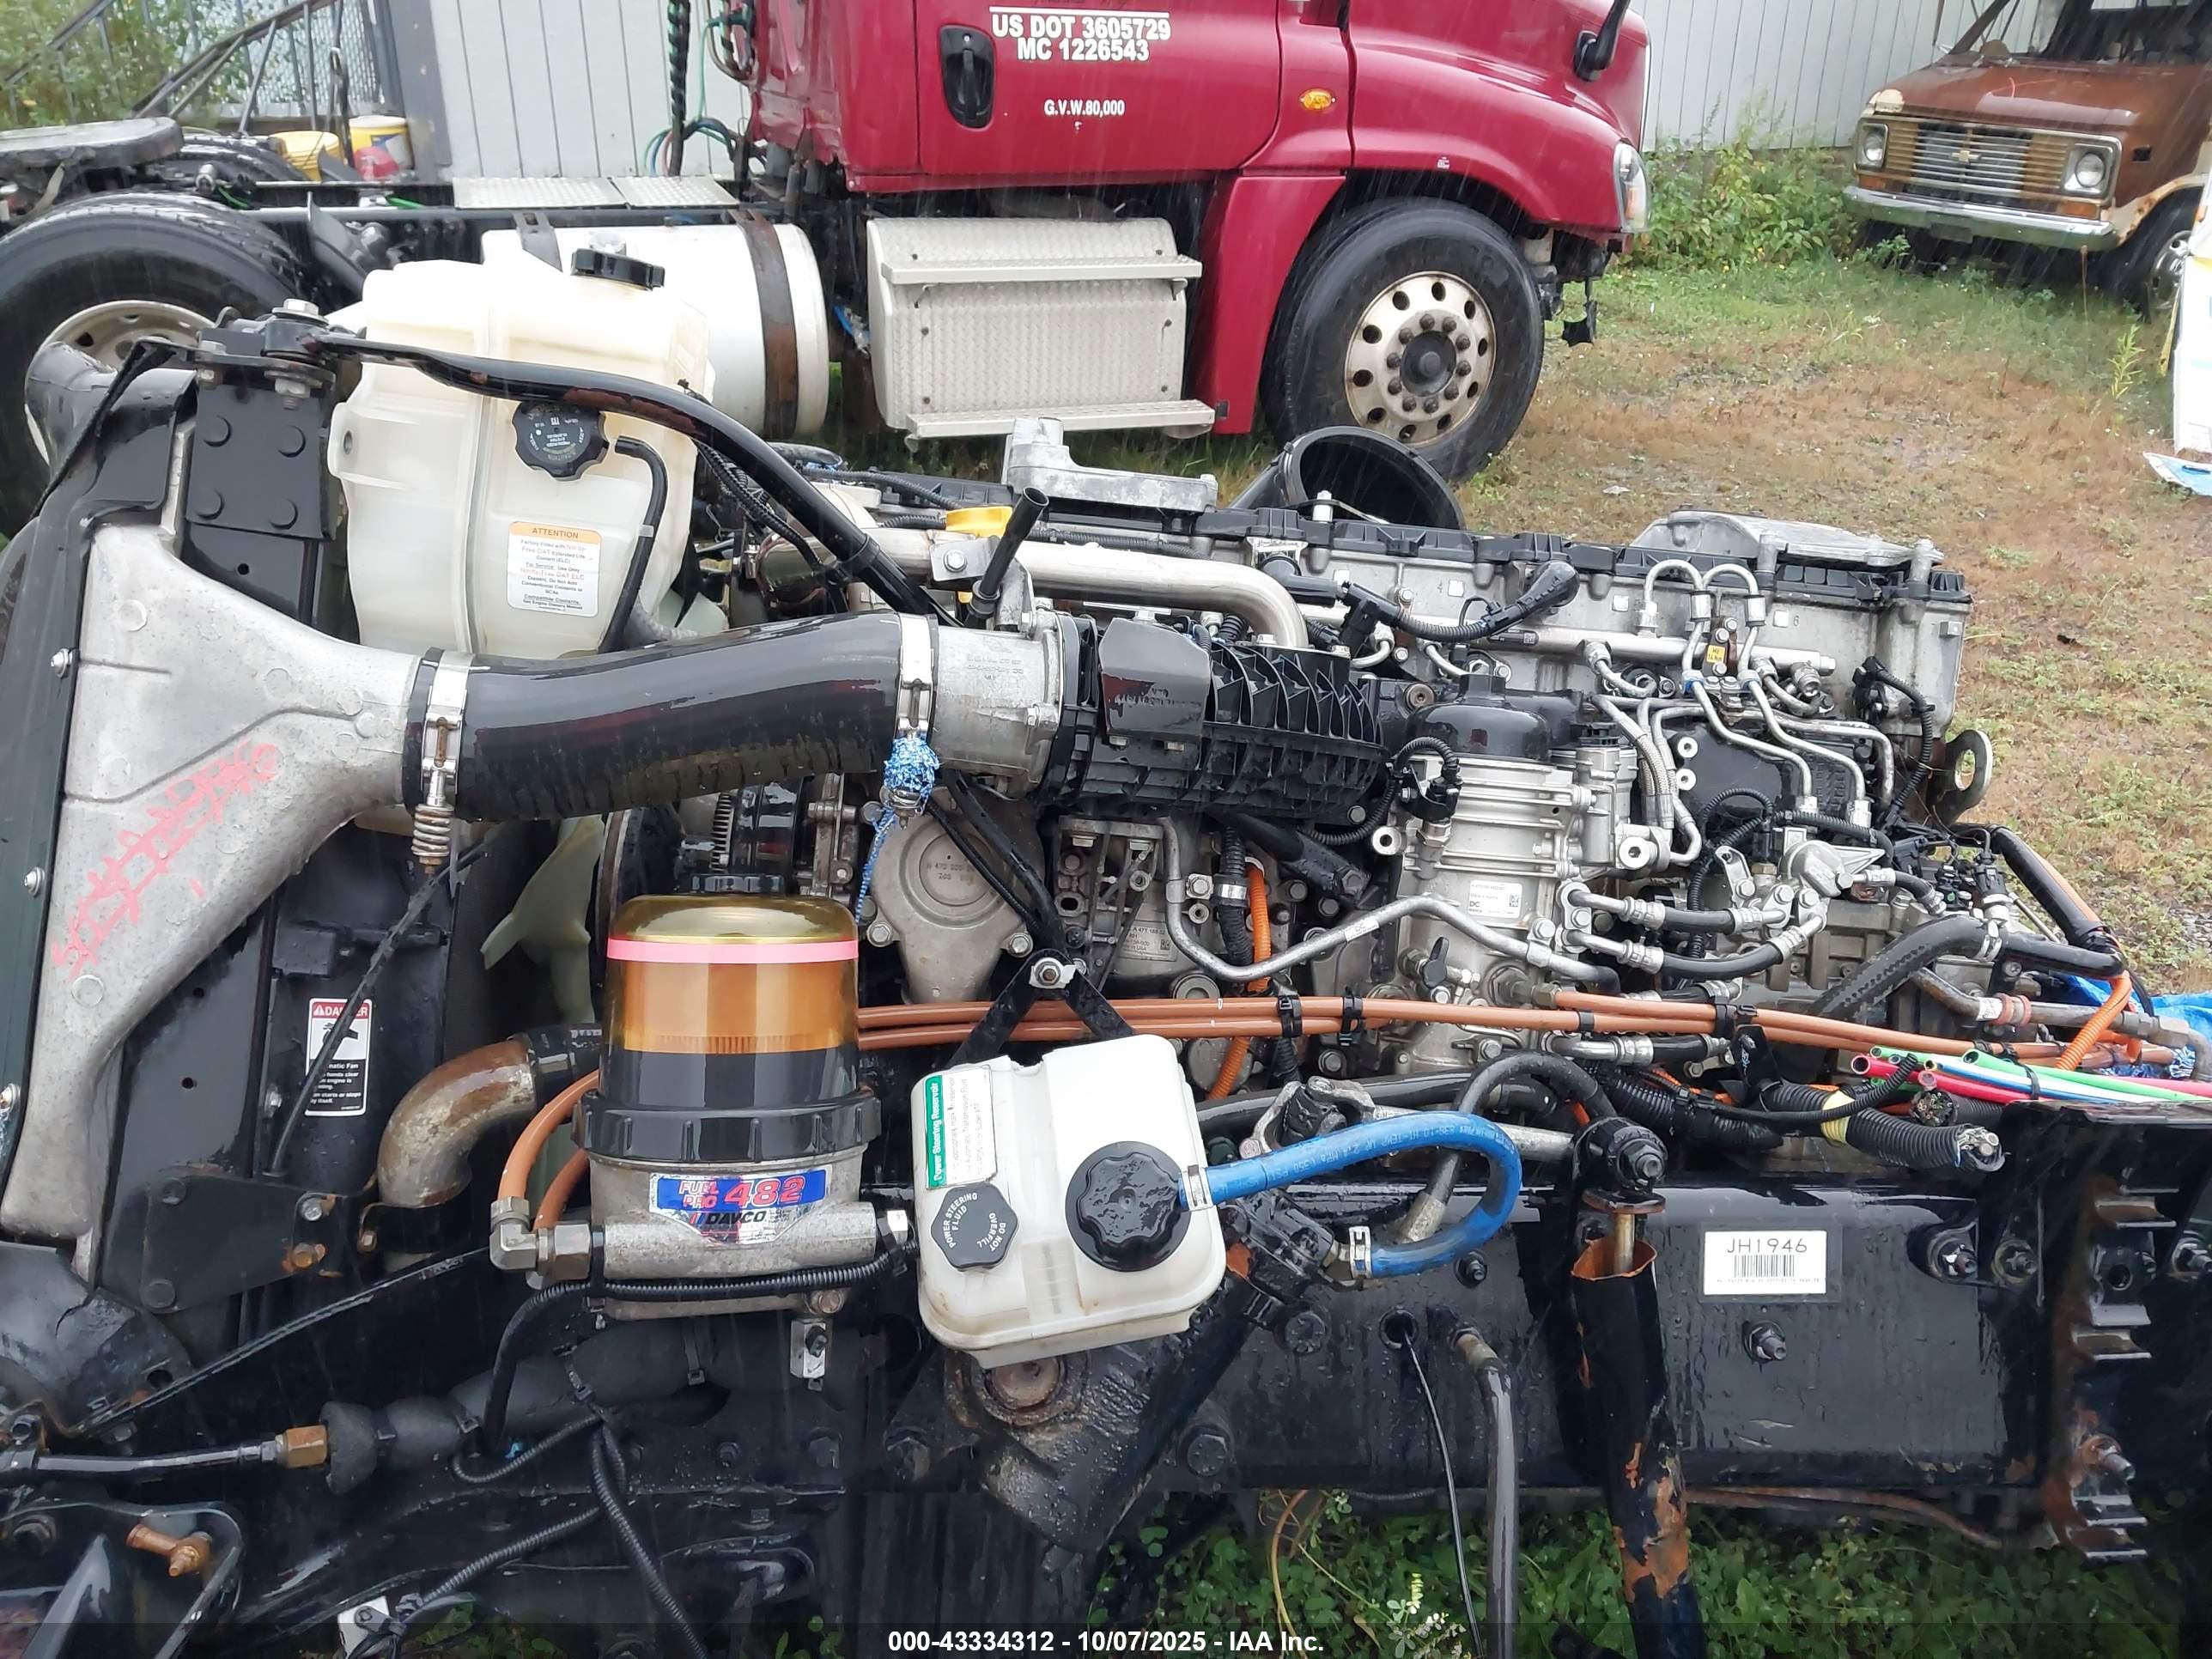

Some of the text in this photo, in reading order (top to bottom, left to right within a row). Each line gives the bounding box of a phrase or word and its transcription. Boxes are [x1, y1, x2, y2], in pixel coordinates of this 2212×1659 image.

[992, 14, 1171, 40] US DOT 3605729
[1018, 38, 1149, 61] MC 1226543
[1044, 100, 1125, 116] G.V.W.80,000
[532, 528, 578, 539] ATTENTION
[930, 1082, 943, 1181] Power Steering Reservoir
[679, 1181, 719, 1195] FUEL
[724, 1176, 806, 1207] 482
[683, 1195, 718, 1208] PRO
[705, 1210, 768, 1225] DAVCO
[943, 1192, 978, 1248] POWER STEERING
[952, 1206, 967, 1231] FLUID
[977, 1212, 998, 1249] OVERFILL
[989, 1222, 1006, 1252] DO NOT
[1727, 1238, 1807, 1253] JH1946
